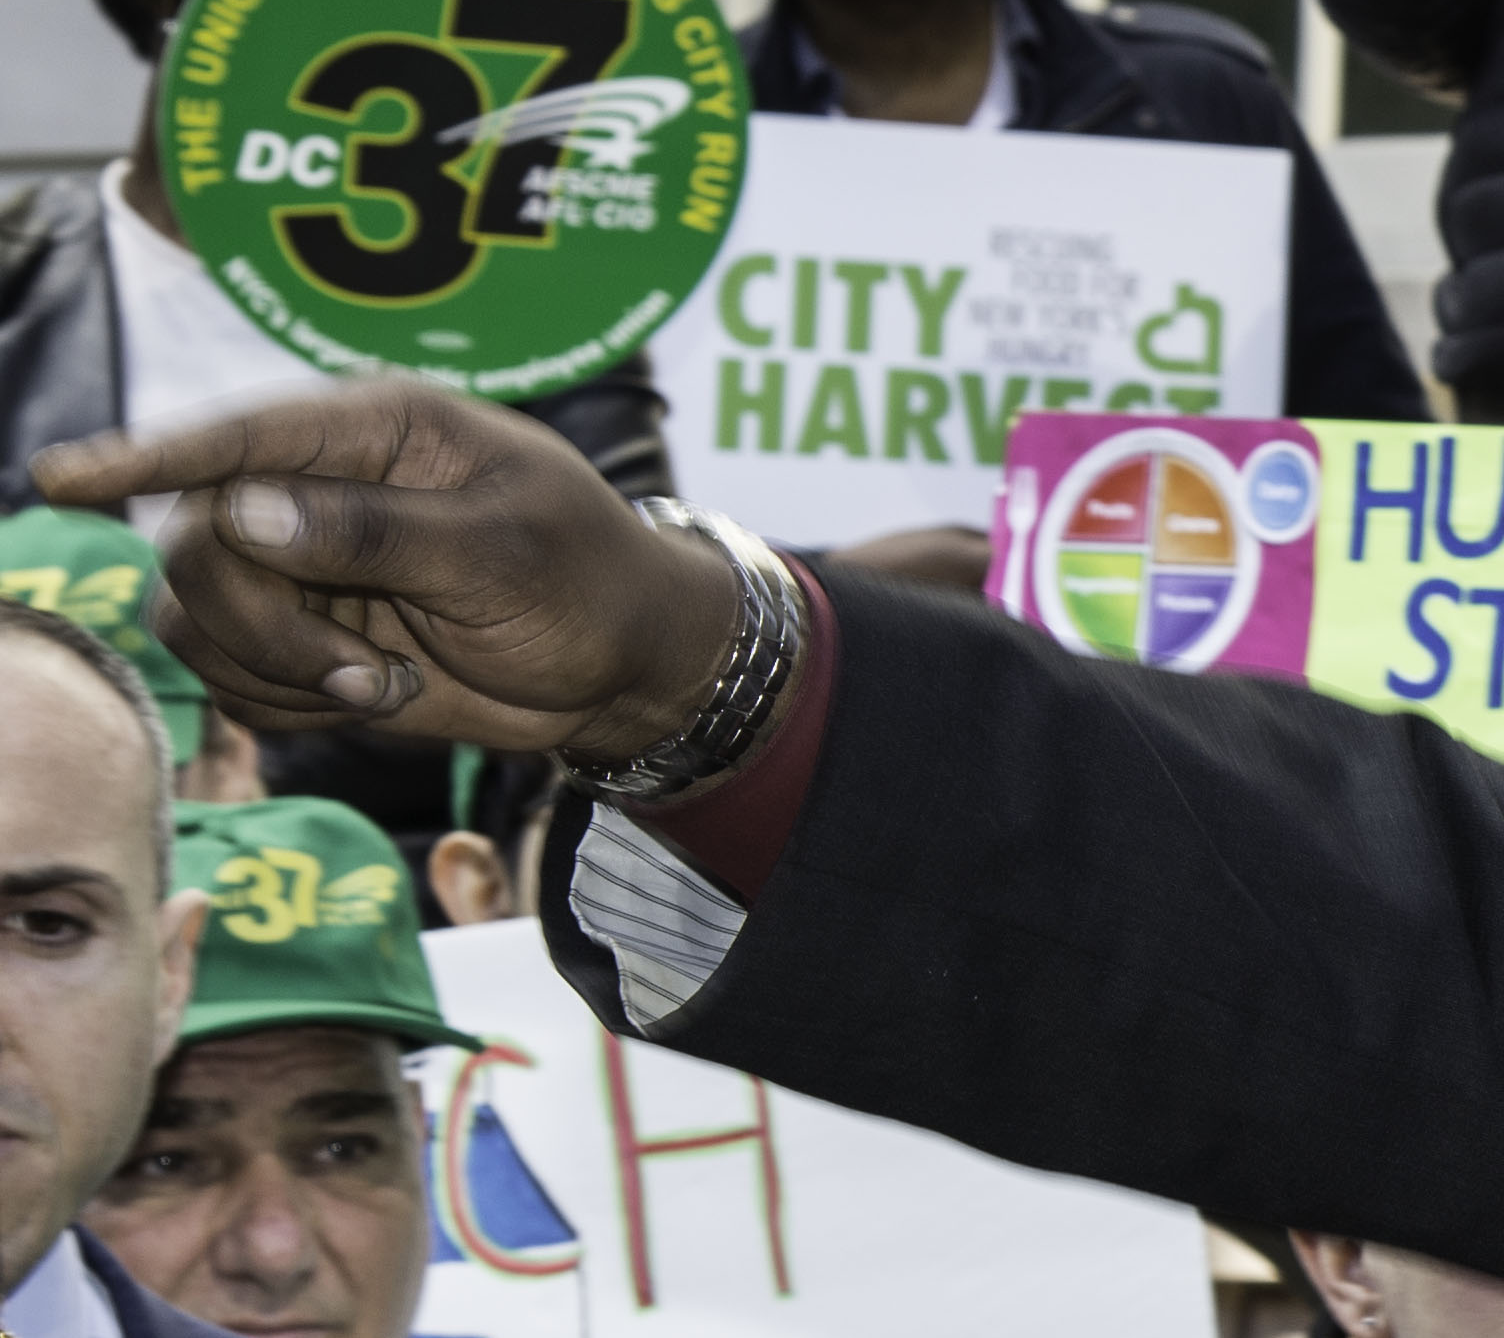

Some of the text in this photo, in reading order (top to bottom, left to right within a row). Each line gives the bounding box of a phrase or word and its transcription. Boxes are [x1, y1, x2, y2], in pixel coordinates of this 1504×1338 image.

[673, 15, 739, 121] CITY
[174, 97, 225, 197] THE
[234, 128, 342, 189] DC
[678, 131, 740, 234] RUN
[715, 252, 969, 359] CITY
[211, 845, 323, 944] 37
